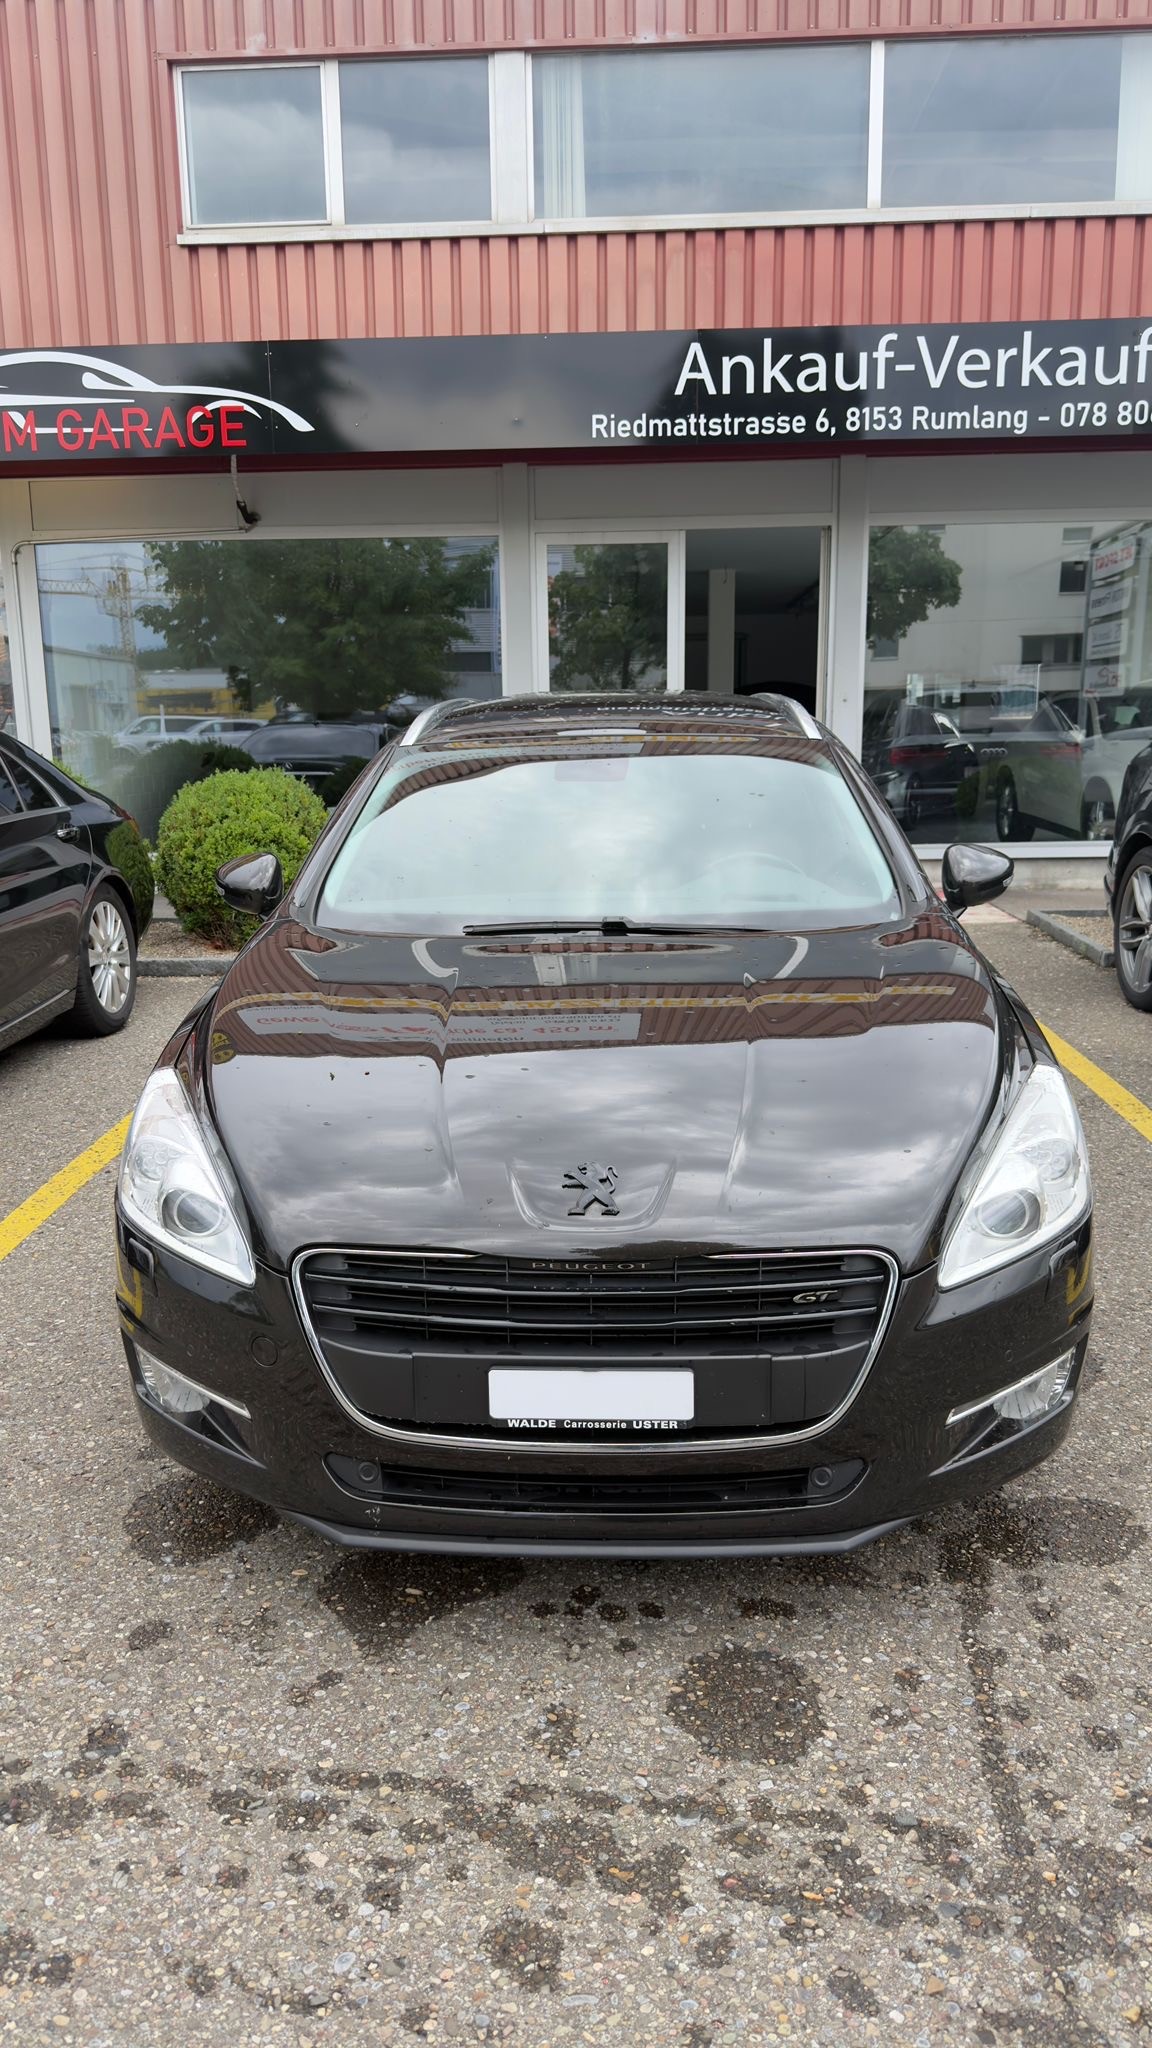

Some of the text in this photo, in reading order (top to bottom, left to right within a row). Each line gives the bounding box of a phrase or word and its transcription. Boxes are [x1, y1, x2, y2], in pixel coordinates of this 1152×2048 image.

[674, 326, 1152, 396] Ankauf-Verkauf
[56, 405, 248, 451] GARAGE
[591, 411, 806, 439] Riedmattstrasse
[815, 408, 836, 437] 6,
[845, 405, 903, 431] 8153
[912, 404, 1028, 435] Rumlang
[1060, 402, 1107, 428] 078
[1117, 400, 1152, 426] 80
[532, 1262, 650, 1270] PEUGEOT
[792, 1289, 839, 1304] GT
[507, 1419, 678, 1429] WALDE Carrosserie USTER
